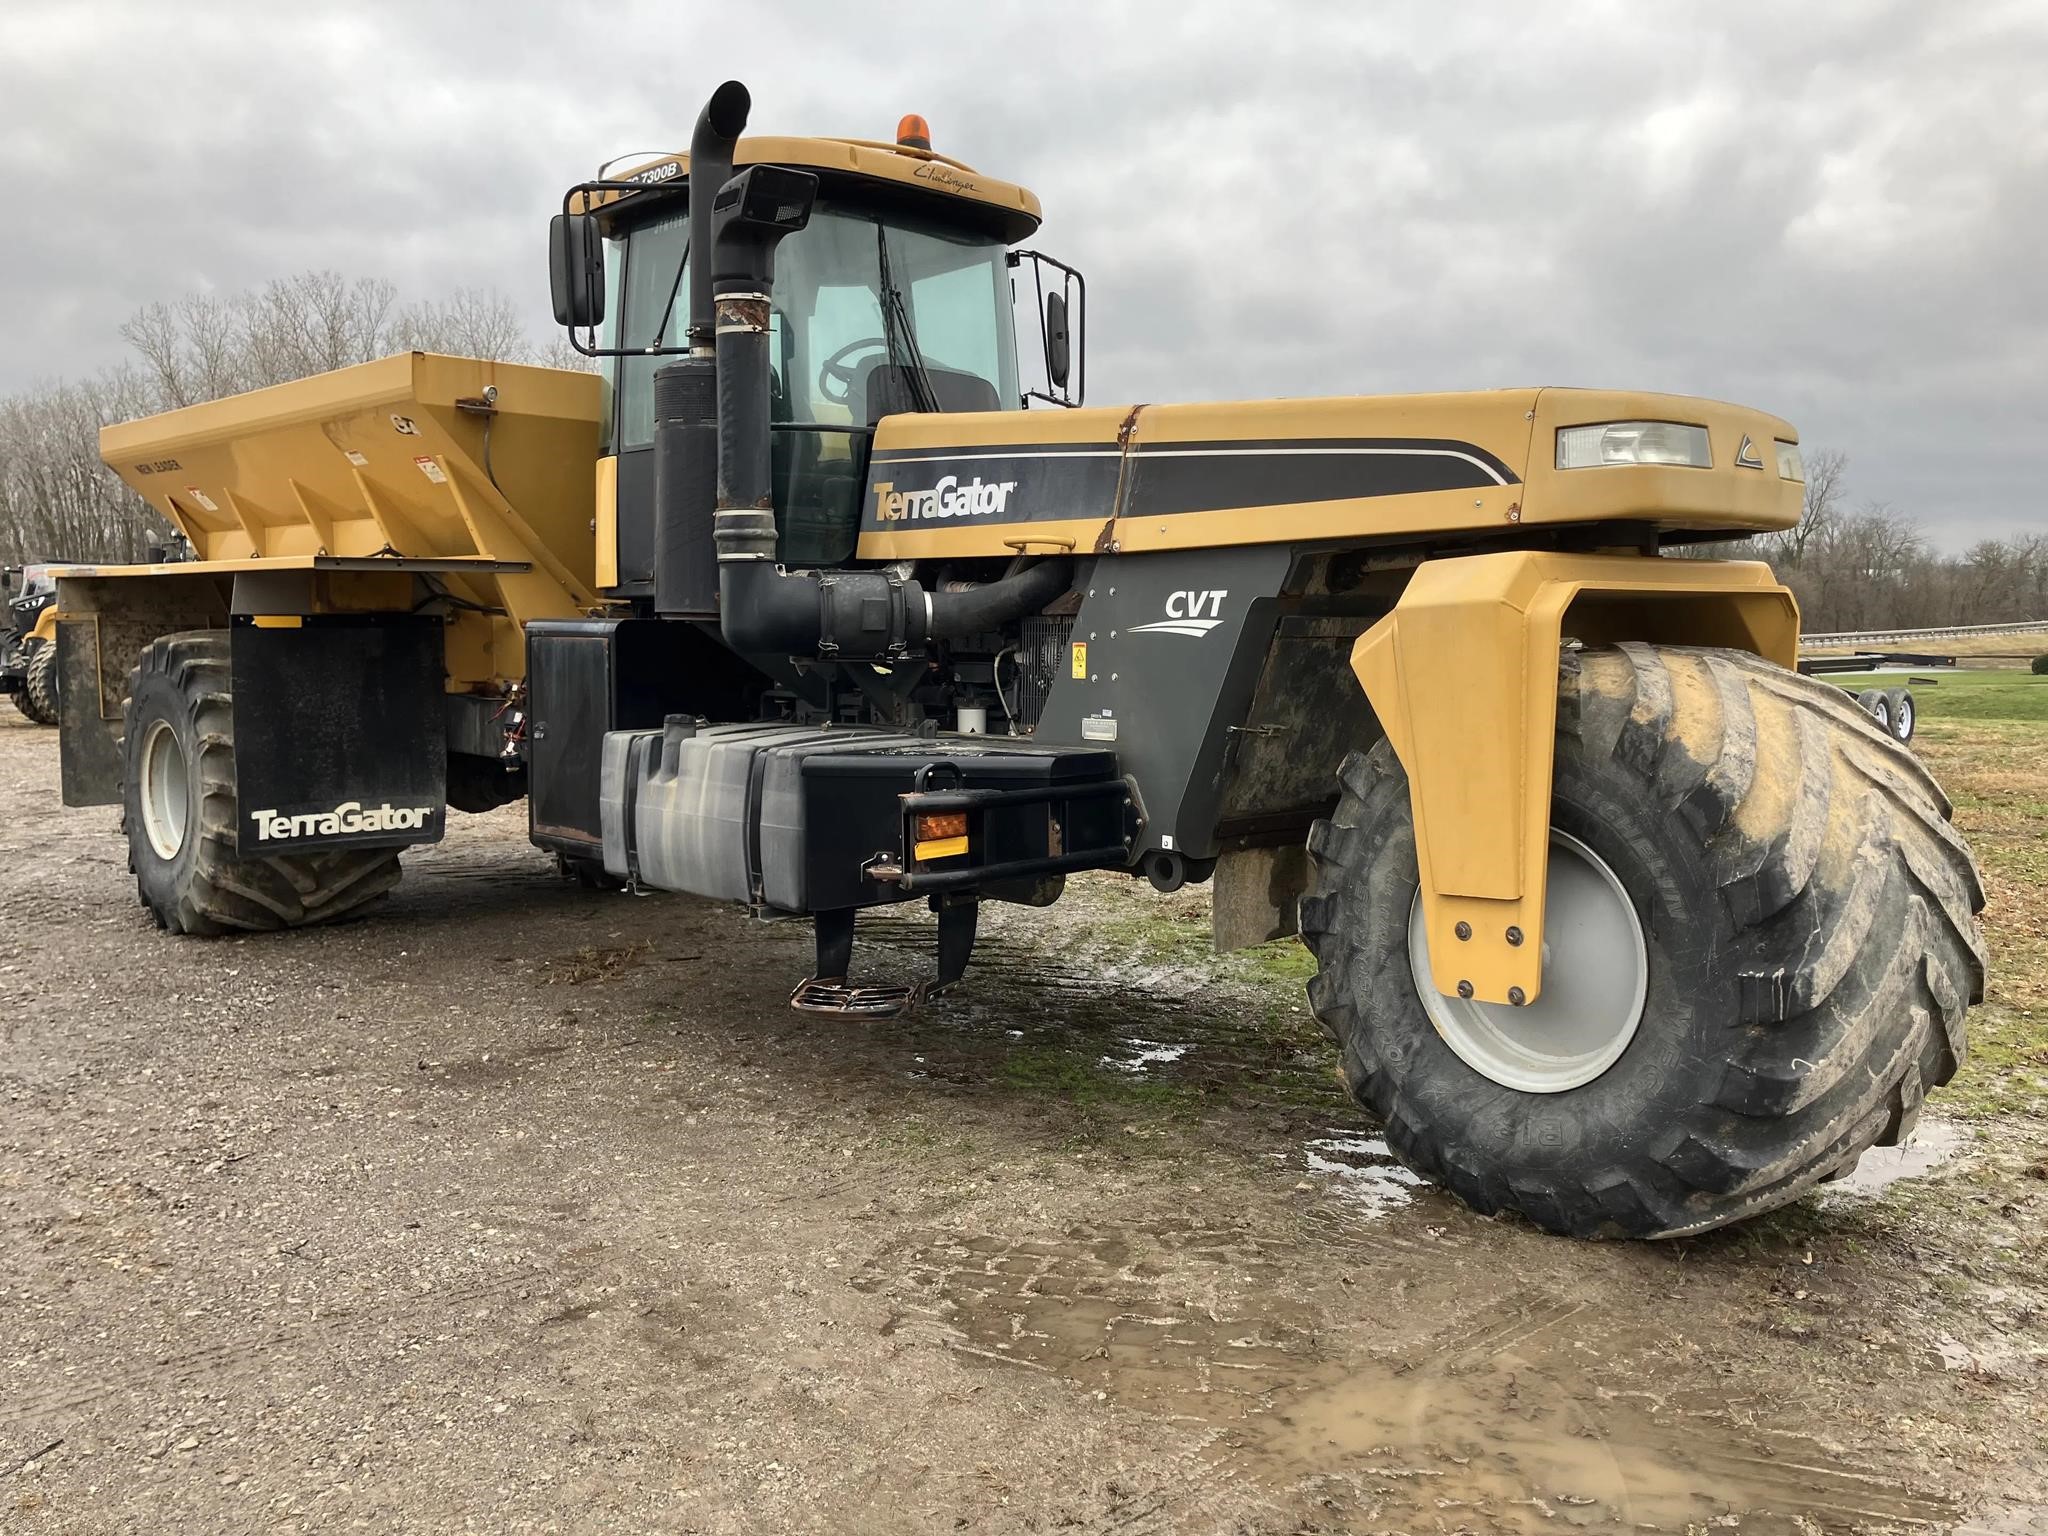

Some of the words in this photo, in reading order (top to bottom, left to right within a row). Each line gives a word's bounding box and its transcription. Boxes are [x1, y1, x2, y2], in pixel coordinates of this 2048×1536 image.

[641, 162, 677, 184] 7300B
[873, 475, 1016, 521] TerraGator
[1165, 590, 1227, 618] CVT
[251, 801, 430, 841] TerraGator
